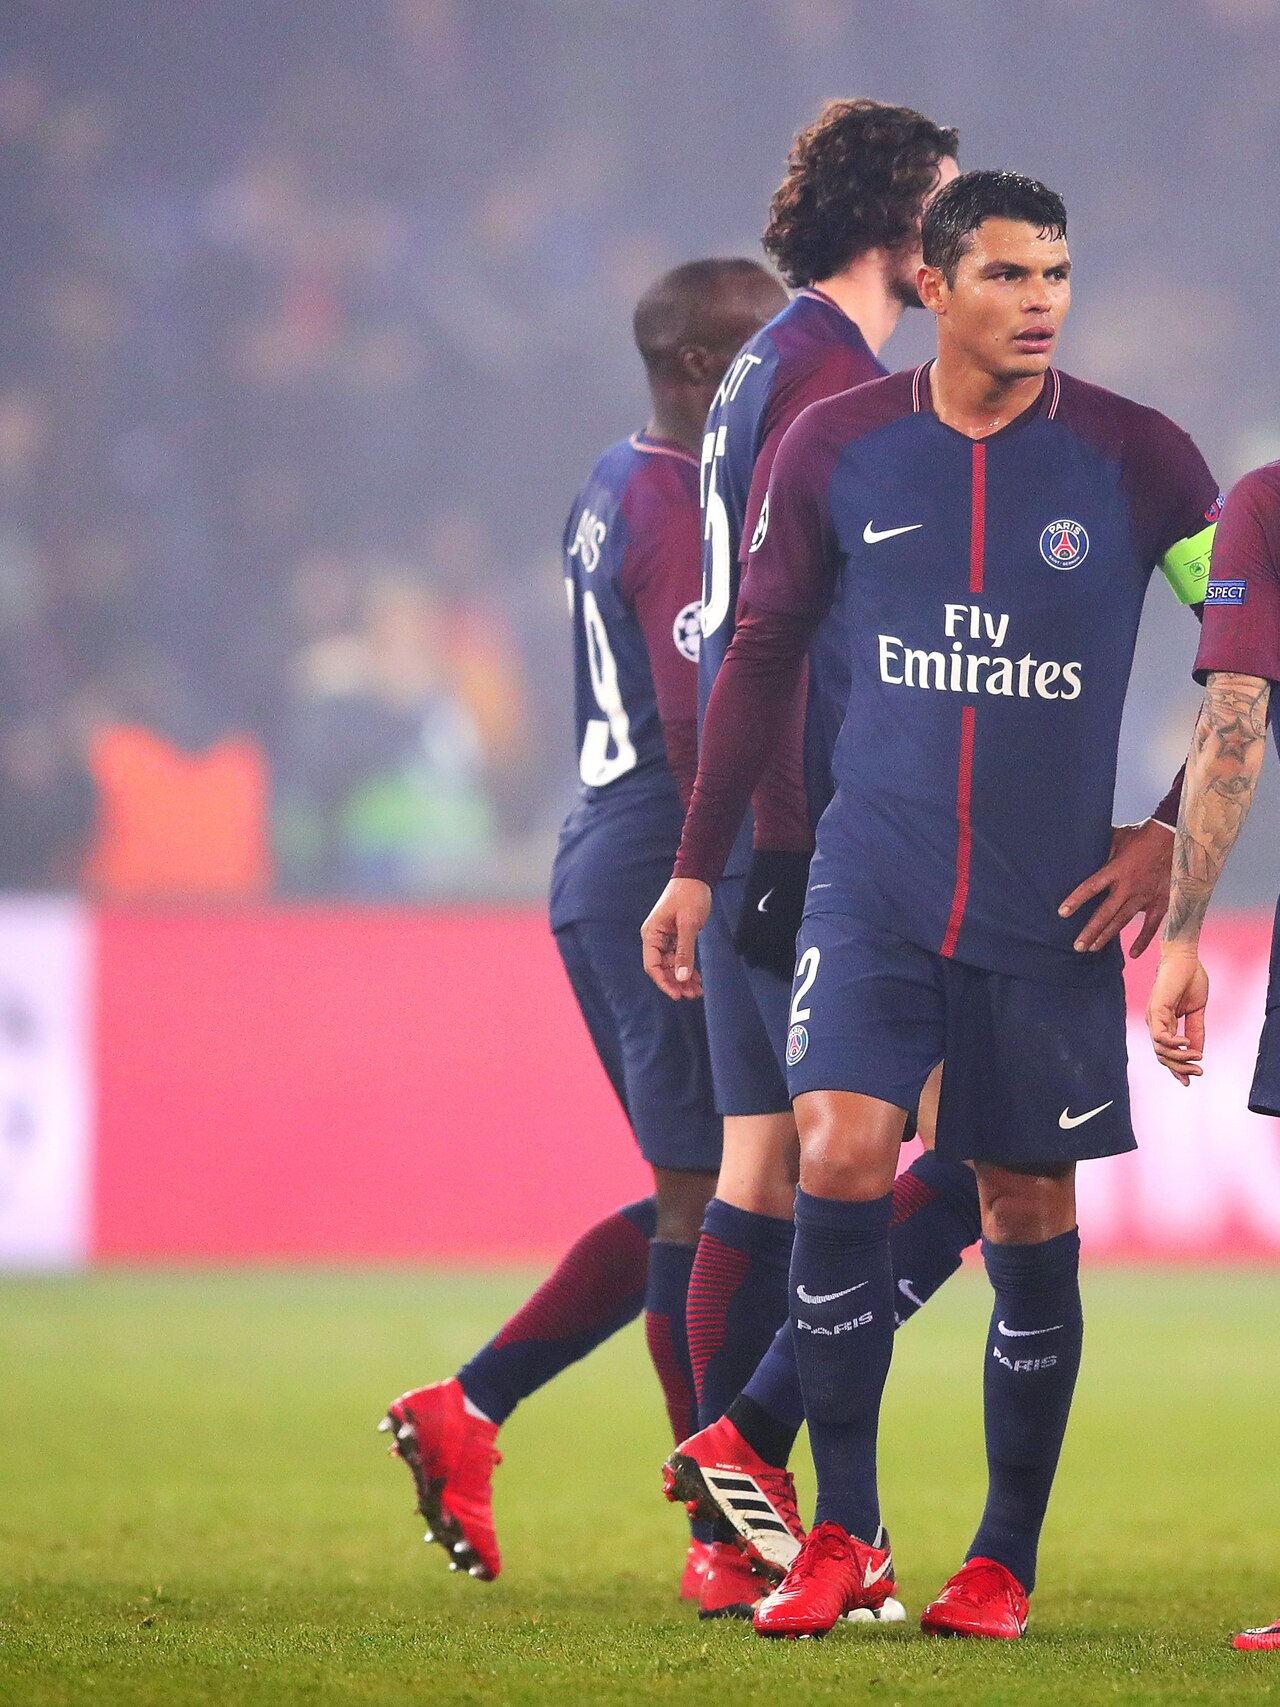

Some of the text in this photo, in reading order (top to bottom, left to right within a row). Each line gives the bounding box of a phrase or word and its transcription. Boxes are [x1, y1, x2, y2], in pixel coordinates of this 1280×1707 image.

[1048, 522, 1082, 535] PARIS
[1205, 586, 1246, 600] SPECT
[944, 603, 1010, 648] Fly
[877, 634, 1083, 701] Emirates
[789, 946, 821, 1027] 2
[797, 1311, 875, 1336] PARIS
[993, 1346, 1058, 1372] PARIS
